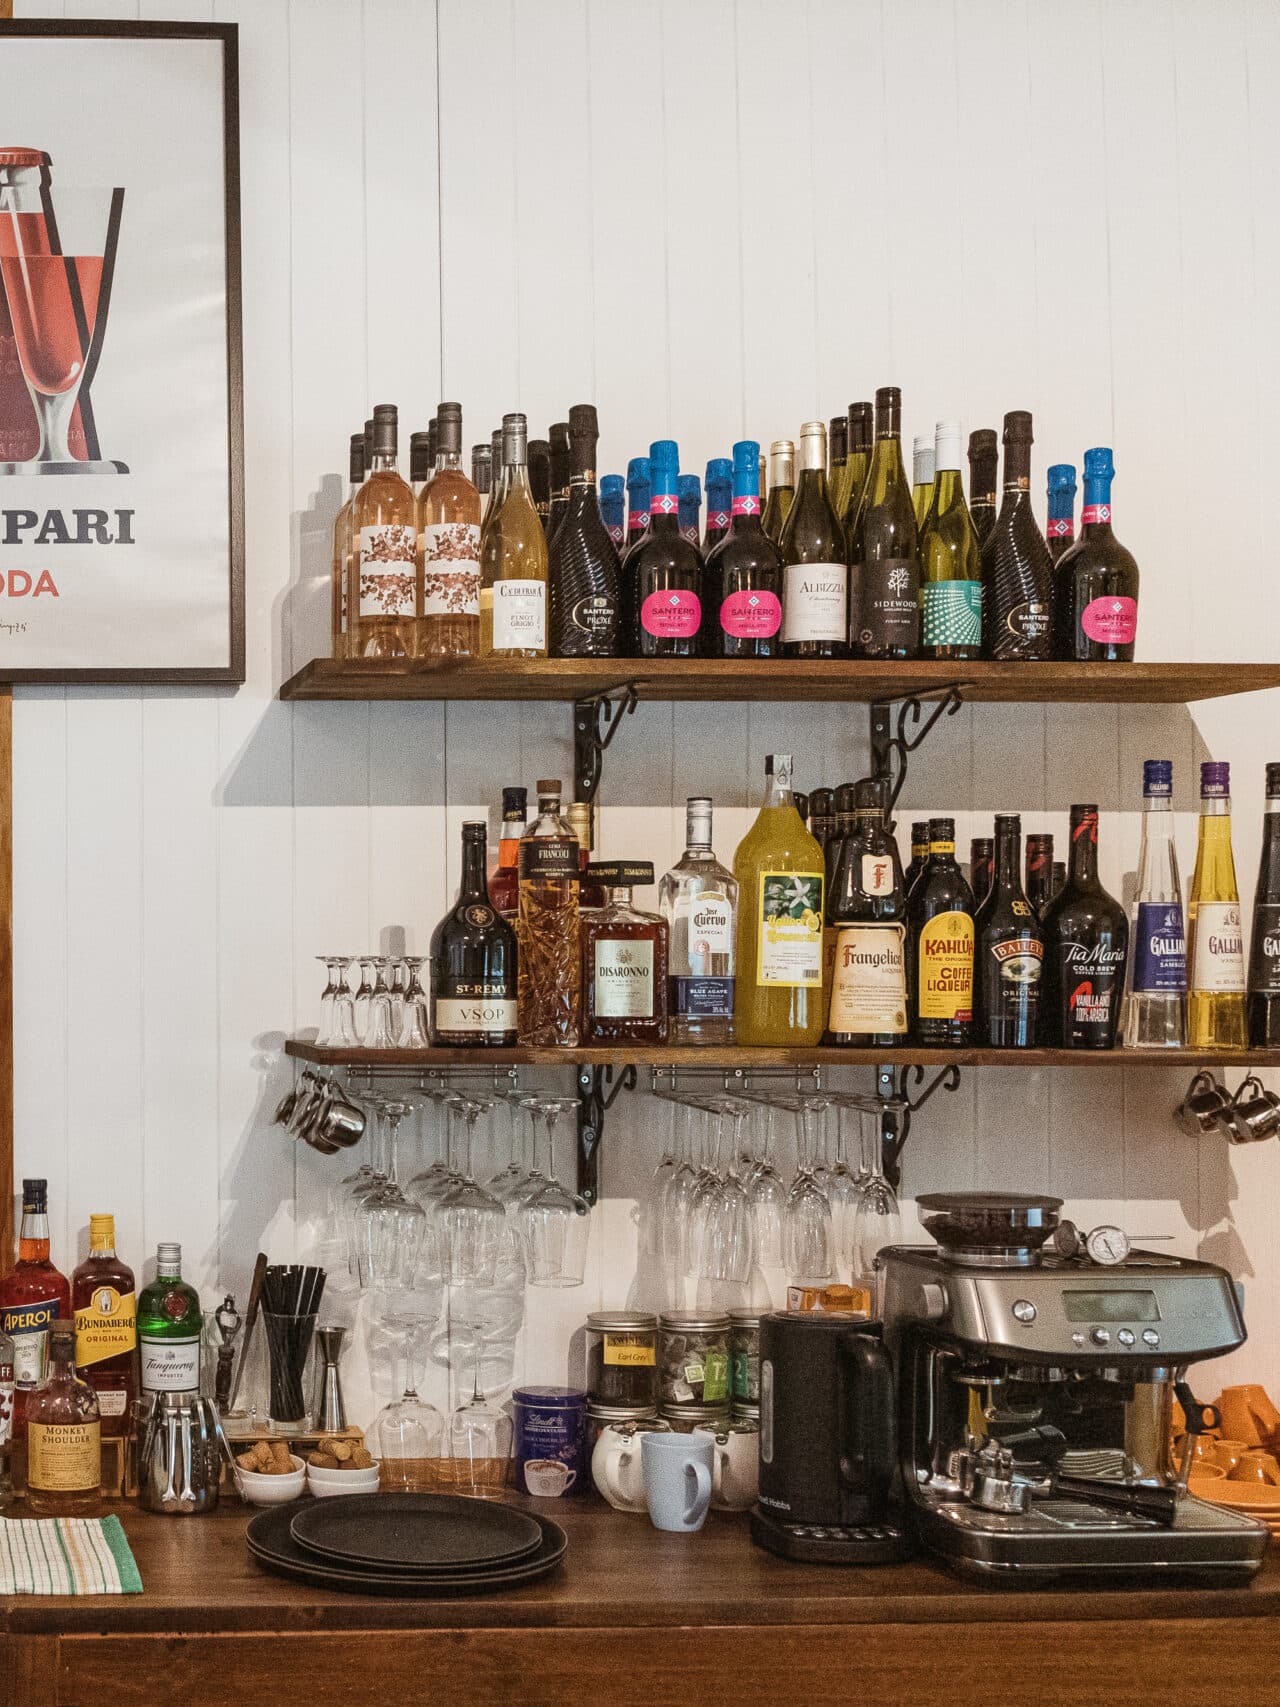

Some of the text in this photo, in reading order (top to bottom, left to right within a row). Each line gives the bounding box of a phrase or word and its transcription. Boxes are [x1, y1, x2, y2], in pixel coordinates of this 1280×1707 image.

[874, 601, 917, 609] SIDEWOOD
[652, 607, 695, 616] SANTERO
[731, 608, 775, 616] SANTERO
[539, 850, 569, 859] FRANCOLI
[693, 912, 726, 928] Cuervo
[842, 944, 902, 968] Frangelico
[1061, 942, 1125, 965] Tia Maria
[600, 966, 650, 978] DISARONNO
[1002, 989, 1040, 997] ORIGINAL
[1076, 994, 1099, 1008] VANILLA
[460, 1008, 504, 1021] VSOP
[77, 1316, 136, 1331] BUNDABERG
[86, 1335, 128, 1343] ORIGINAL
[617, 1353, 632, 1361] Earl
[146, 1358, 194, 1373] Tanqueray
[713, 1361, 728, 1381] T2
[46, 1426, 86, 1435] MONKEY
[42, 1434, 90, 1444] SHOULDER
